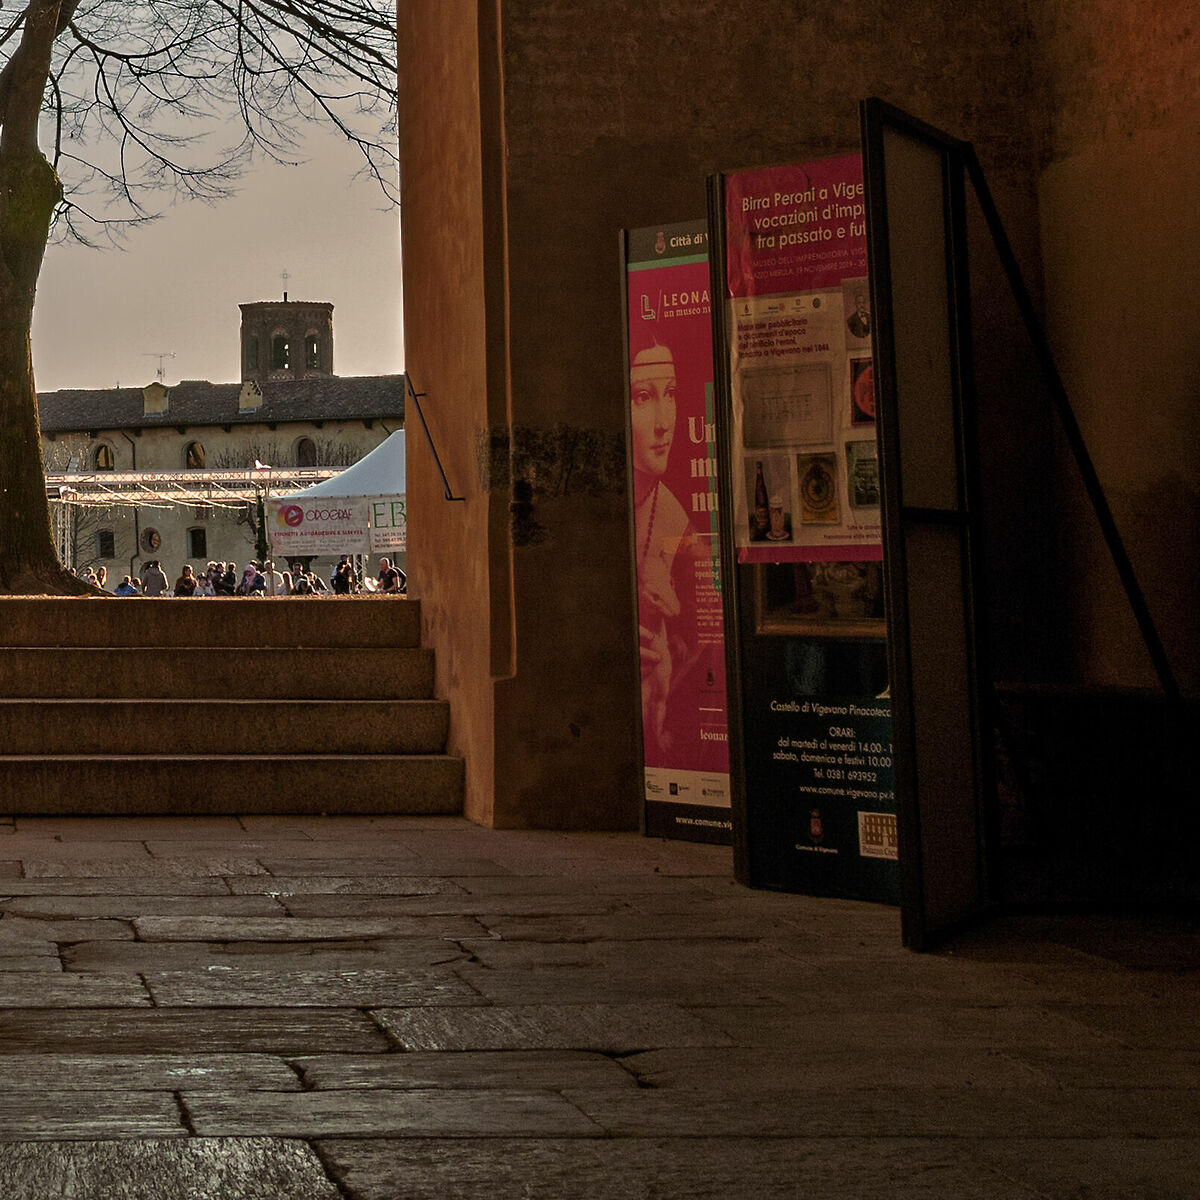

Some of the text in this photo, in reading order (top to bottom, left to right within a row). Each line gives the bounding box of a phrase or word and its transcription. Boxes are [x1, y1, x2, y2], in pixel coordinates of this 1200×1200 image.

[742, 182, 864, 212] Birra Peroni a Vige
[754, 206, 818, 229] vocazioni
[670, 234, 692, 248] Città
[694, 233, 703, 245] di
[757, 234, 775, 249] tra
[779, 226, 832, 250] passato
[837, 226, 846, 239] e
[663, 289, 710, 307] LEONA
[664, 310, 675, 318] un
[676, 307, 701, 317] museo
[768, 318, 808, 330] pubblicitario
[770, 347, 801, 357] Vigevano
[770, 700, 801, 712] Castello
[801, 701, 810, 712] di
[811, 702, 848, 716] Vigevano
[828, 726, 856, 738] ORARI:
[777, 736, 790, 747] dal
[819, 739, 827, 750] al
[858, 742, 882, 753] 14.00
[772, 749, 799, 762] sabato,
[800, 751, 836, 763] domenica
[844, 753, 865, 765] festivi
[867, 756, 892, 767] 10.00
[826, 769, 845, 780] 0381
[847, 770, 877, 782] 693952
